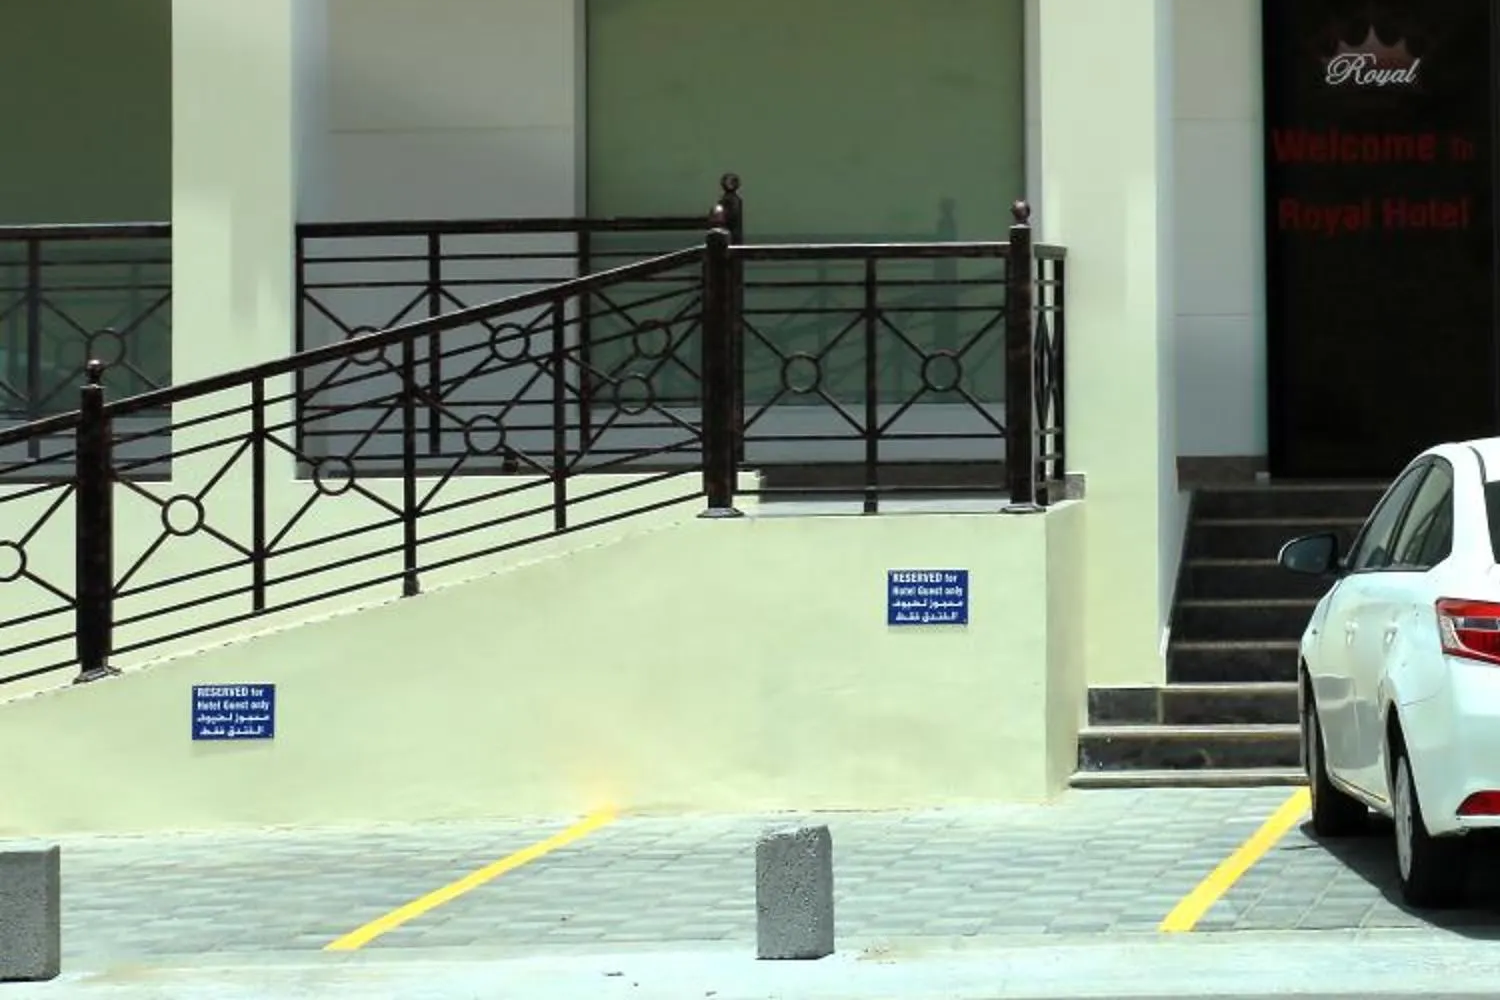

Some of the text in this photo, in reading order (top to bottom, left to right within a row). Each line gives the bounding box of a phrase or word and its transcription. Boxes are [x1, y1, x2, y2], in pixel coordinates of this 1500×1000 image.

[1324, 52, 1423, 87] Royal
[1271, 126, 1437, 164] Welcome
[1278, 194, 1471, 236] Royal Hotel
